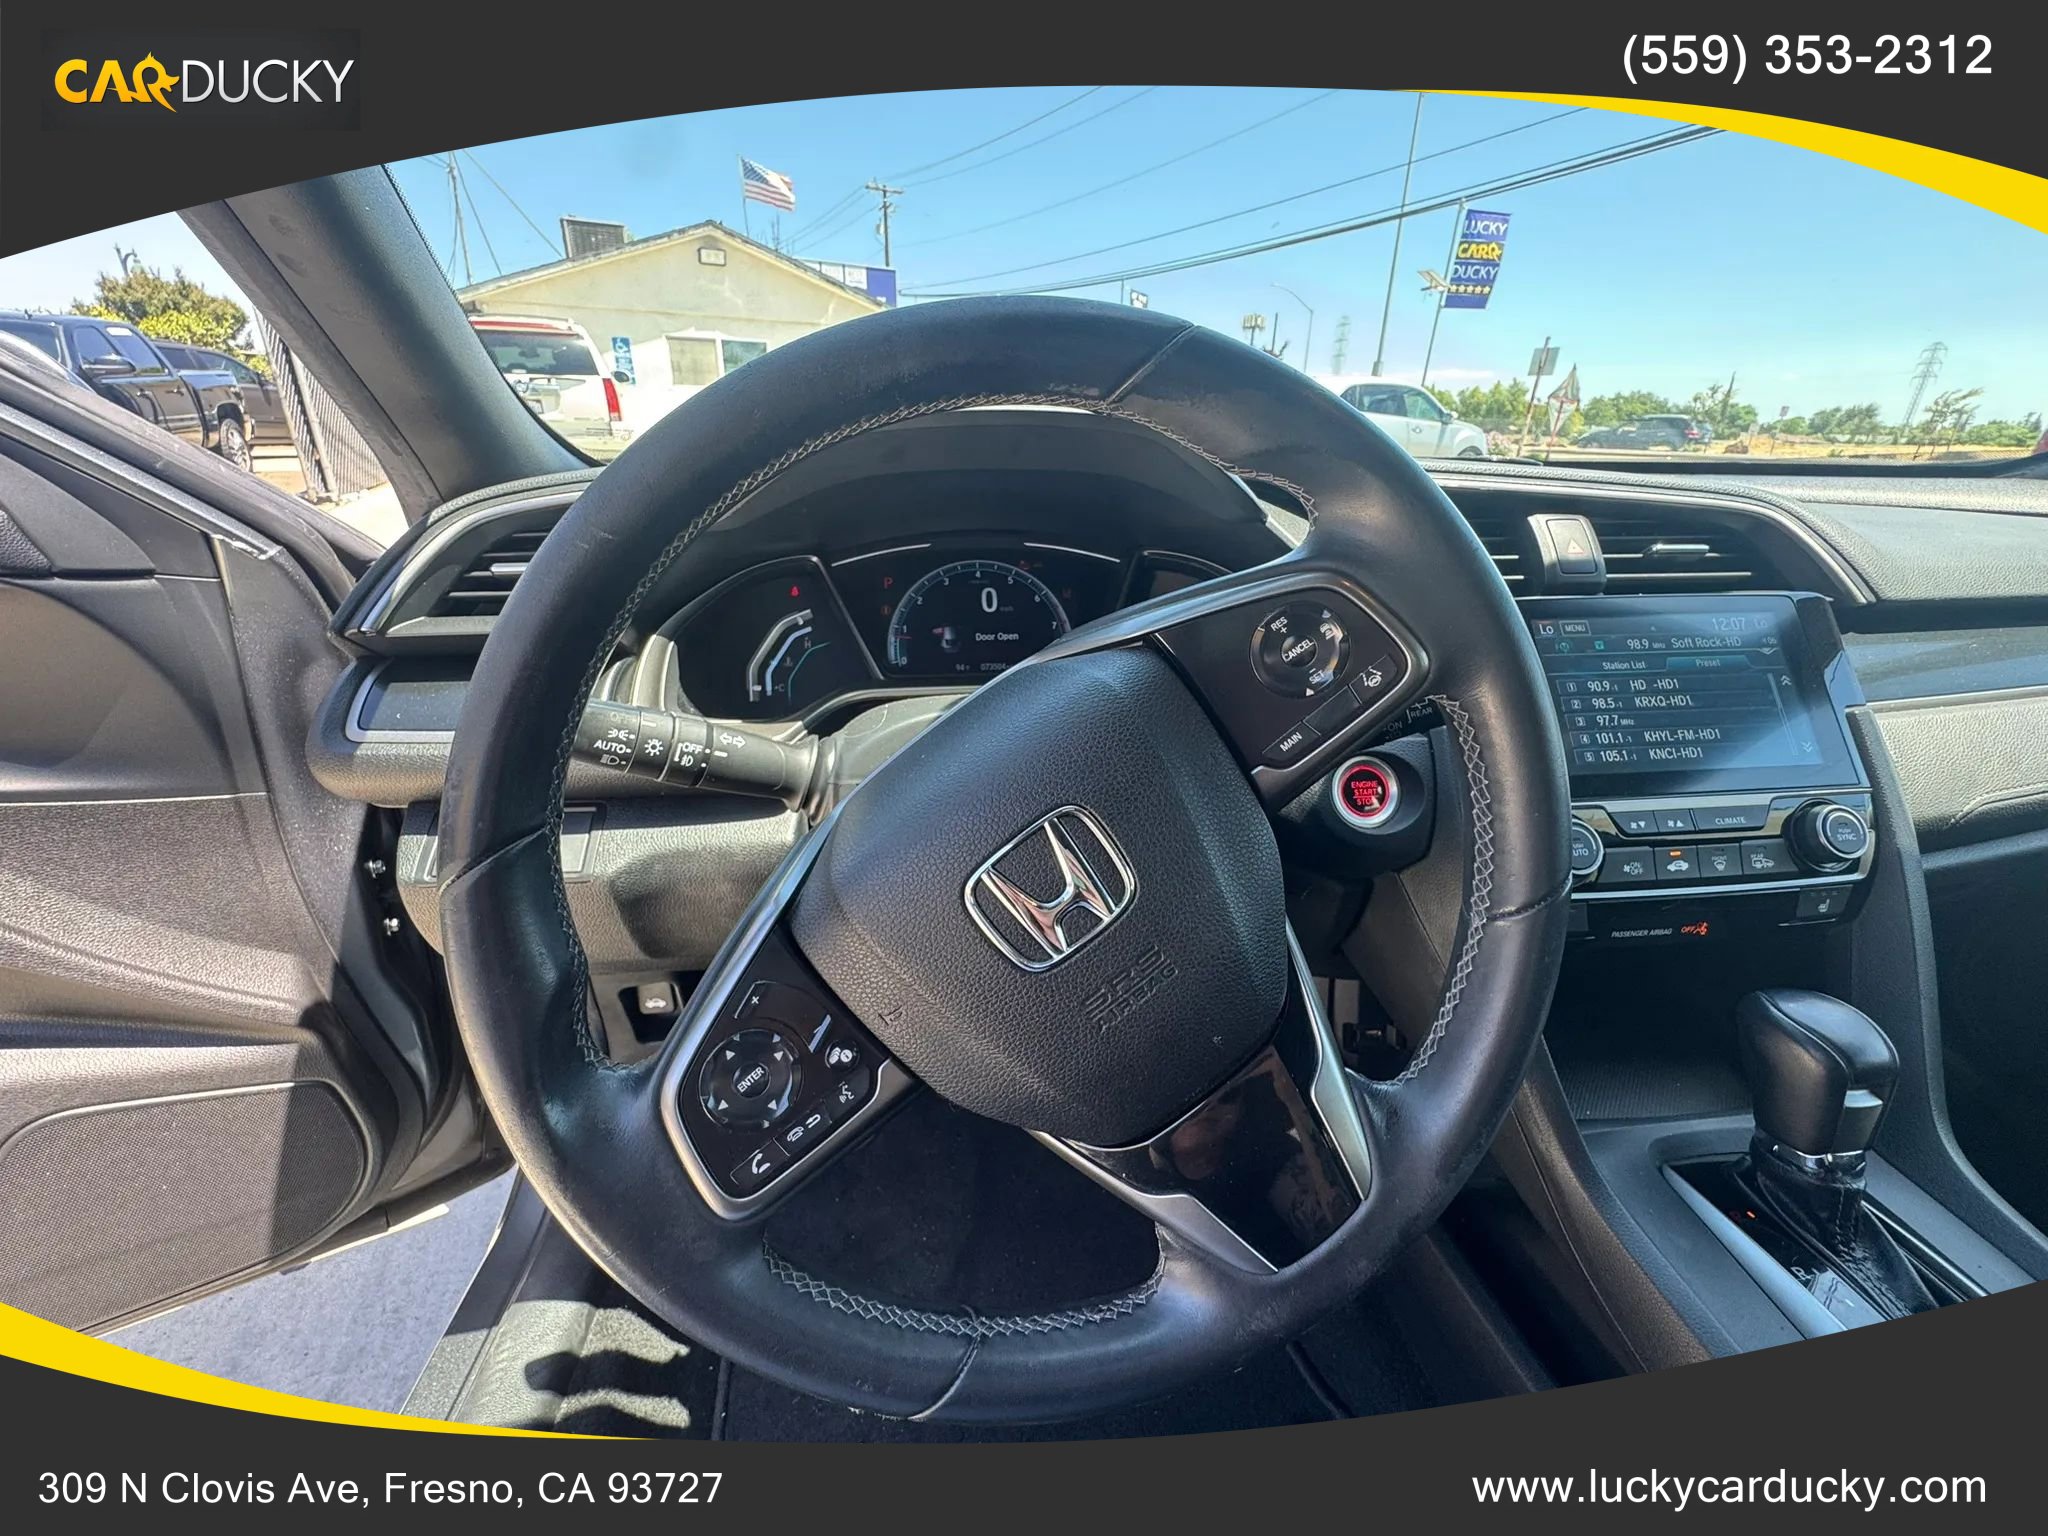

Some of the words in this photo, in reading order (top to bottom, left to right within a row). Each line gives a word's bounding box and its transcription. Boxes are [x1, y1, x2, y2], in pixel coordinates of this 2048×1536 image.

[1464, 219, 1508, 236] LUCKY
[1452, 265, 1500, 280] DUCKY
[975, 570, 981, 578] 4
[883, 577, 893, 588] P
[943, 578, 949, 586] 3
[1007, 577, 1014, 585] 5
[916, 597, 923, 605] 2
[981, 587, 998, 612] 0
[1034, 594, 1041, 602] 6
[1051, 621, 1057, 630] 7
[1270, 616, 1288, 632] RES
[1540, 624, 1554, 635] Lo
[1564, 624, 1586, 632] MENU
[1712, 617, 1745, 631] 12:07
[975, 632, 995, 641] Door
[997, 632, 1019, 642] Open
[1627, 638, 1649, 650] 98.9
[1671, 637, 1694, 649] Soft
[1695, 636, 1742, 648] Rock-HD
[1282, 638, 1315, 663] CANCEL
[901, 657, 907, 665] 0
[1602, 660, 1629, 671] Station
[1631, 660, 1646, 669] List
[1695, 658, 1721, 668] Preset
[1308, 670, 1325, 685] SET
[1587, 680, 1610, 692] 90.9
[1630, 679, 1647, 691] HD
[1653, 678, 1680, 690] -HD1
[1592, 697, 1615, 709] 98.5
[1634, 695, 1692, 708] KRXQ-HD1
[1409, 707, 1433, 719] REAR
[1596, 714, 1619, 727] 97.7
[1279, 731, 1302, 752] MAIN
[1595, 732, 1623, 744] 101.1
[1644, 728, 1721, 742] KHYL-FM-HD1
[593, 740, 625, 754] AUTO
[682, 742, 703, 753] OFF
[1600, 750, 1628, 762] 105.1
[1649, 747, 1703, 760] KNCI-HD1
[1351, 780, 1378, 789] ENGINE
[1353, 788, 1377, 796] START
[1356, 797, 1373, 806] STO
[1715, 816, 1746, 825] CLIMATE
[1837, 833, 1858, 841] SYNC
[1572, 848, 1589, 857] UTO
[1611, 929, 1649, 938] PASSENGER
[1649, 927, 1673, 936] AIRBAG
[1680, 926, 1694, 934] OFF
[736, 1066, 765, 1094] ENTER
